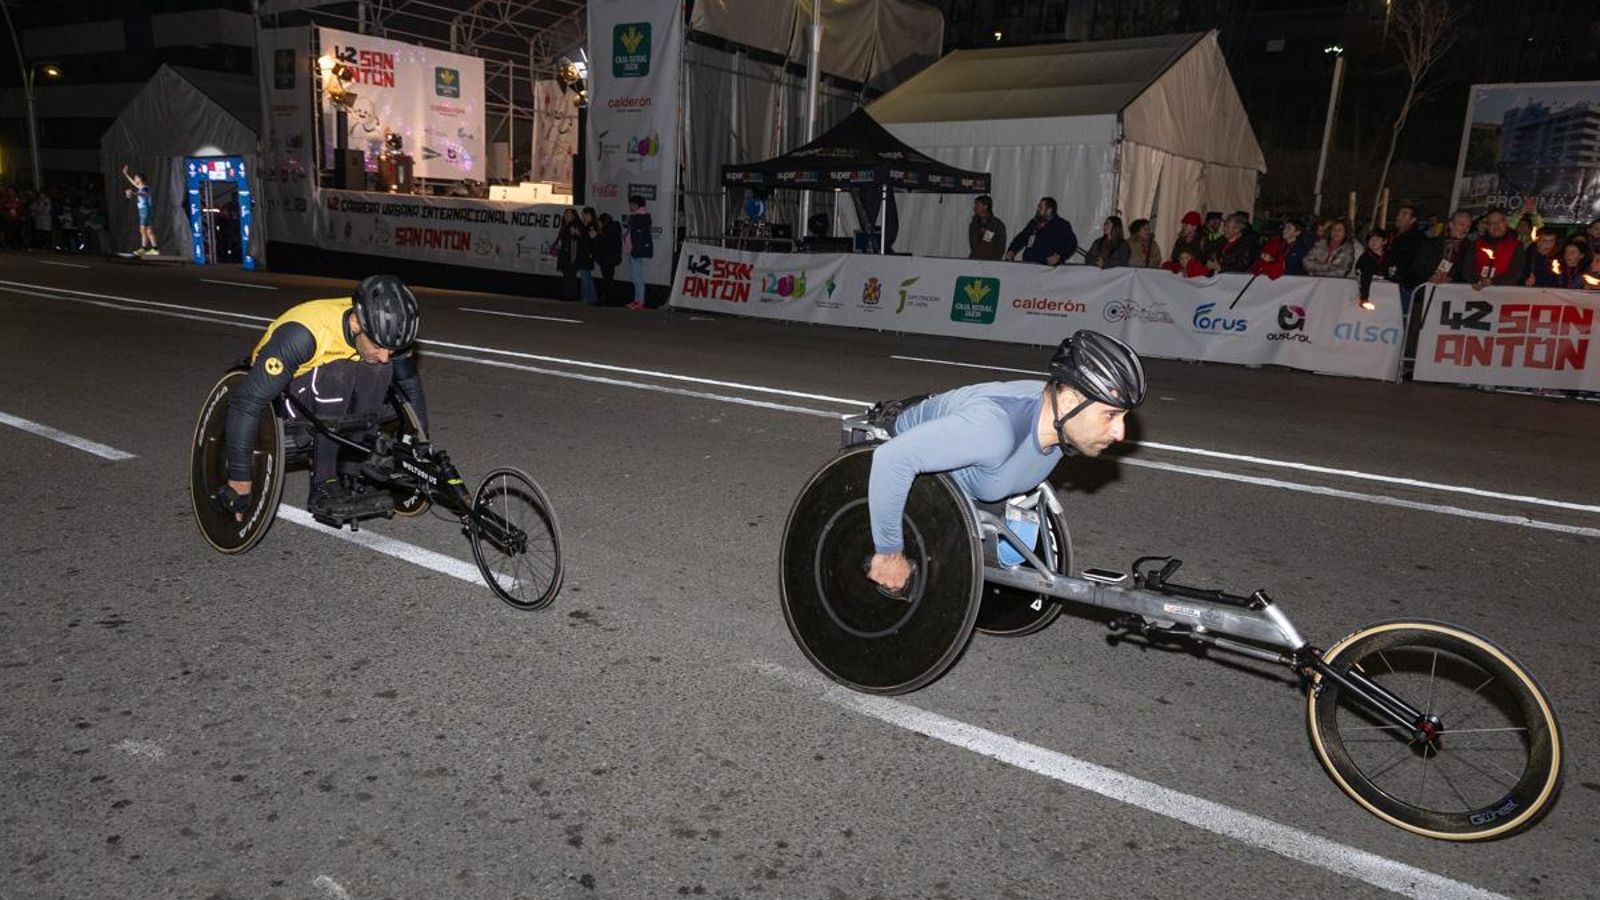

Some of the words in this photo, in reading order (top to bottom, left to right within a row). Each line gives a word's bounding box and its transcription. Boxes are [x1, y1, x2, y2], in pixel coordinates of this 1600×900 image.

[334, 45, 357, 63] 42
[359, 50, 394, 69] SAN
[341, 200, 380, 214] CARRERA
[382, 203, 419, 218] URBANA
[420, 206, 508, 225] INTERNACIONAL
[511, 211, 550, 228] NOCHE
[395, 226, 422, 247] SAN
[687, 255, 711, 276] 42
[711, 258, 754, 281] SAN
[1012, 297, 1086, 313] calderón
[1440, 300, 1493, 331] 42
[1497, 304, 1593, 335] SAN
[1266, 332, 1312, 344] austral
[1333, 320, 1400, 345] alsa
